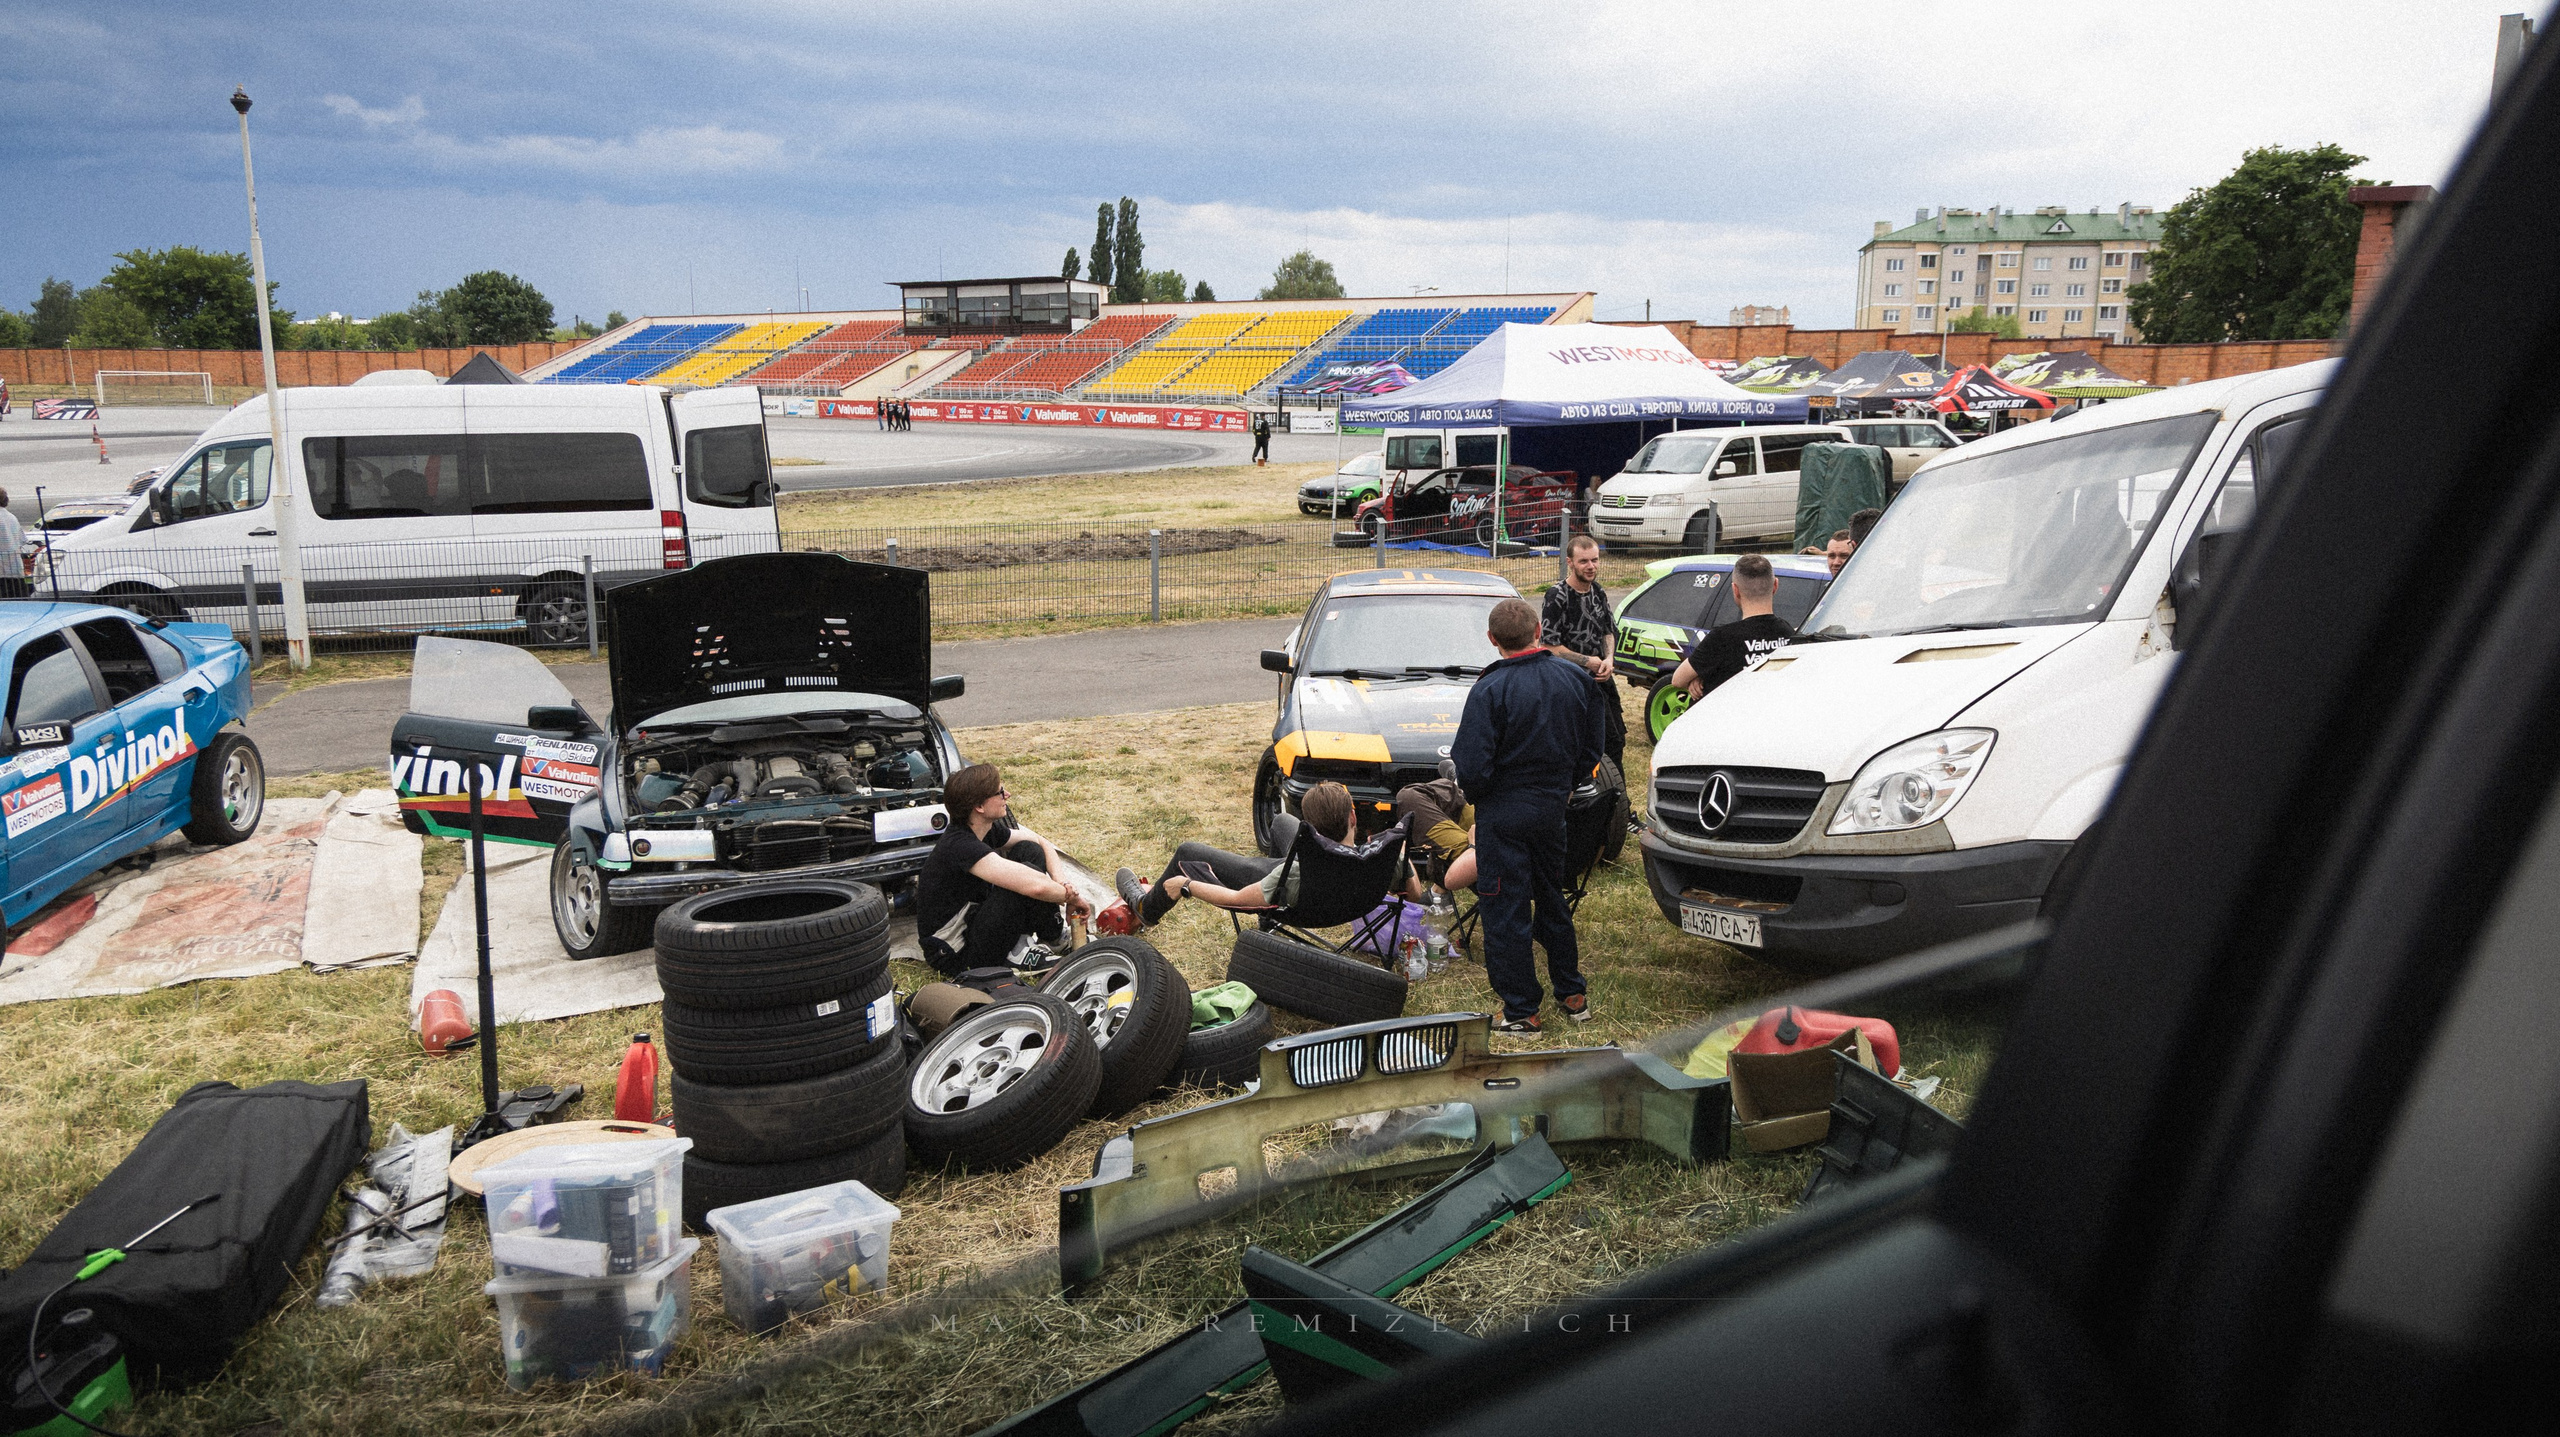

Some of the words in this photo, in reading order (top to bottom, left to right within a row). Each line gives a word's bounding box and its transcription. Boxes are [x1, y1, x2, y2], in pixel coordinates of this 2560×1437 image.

[1226, 416, 1236, 424] 150
[1344, 409, 1410, 423] WESTMOTORS
[1420, 410, 1442, 421] АВТО
[1443, 410, 1463, 421] ПОД
[1465, 408, 1493, 420] ЗАКАЗ
[1560, 404, 1590, 419] АВТО
[1591, 403, 1607, 417] ИЗ
[1609, 402, 1639, 417] США,
[1641, 401, 1685, 415] ЕВРОПЫ,
[1687, 401, 1719, 415] КИТАЯ,
[1722, 401, 1755, 415] КОРЕИ,
[1756, 402, 1775, 415] ОАЭ
[70, 706, 187, 814] Divinol
[22, 781, 62, 805] Valvoline
[9, 798, 64, 832] WESTMOTORS
[1692, 910, 1717, 936] 4367
[1720, 916, 1756, 943] CA-7
